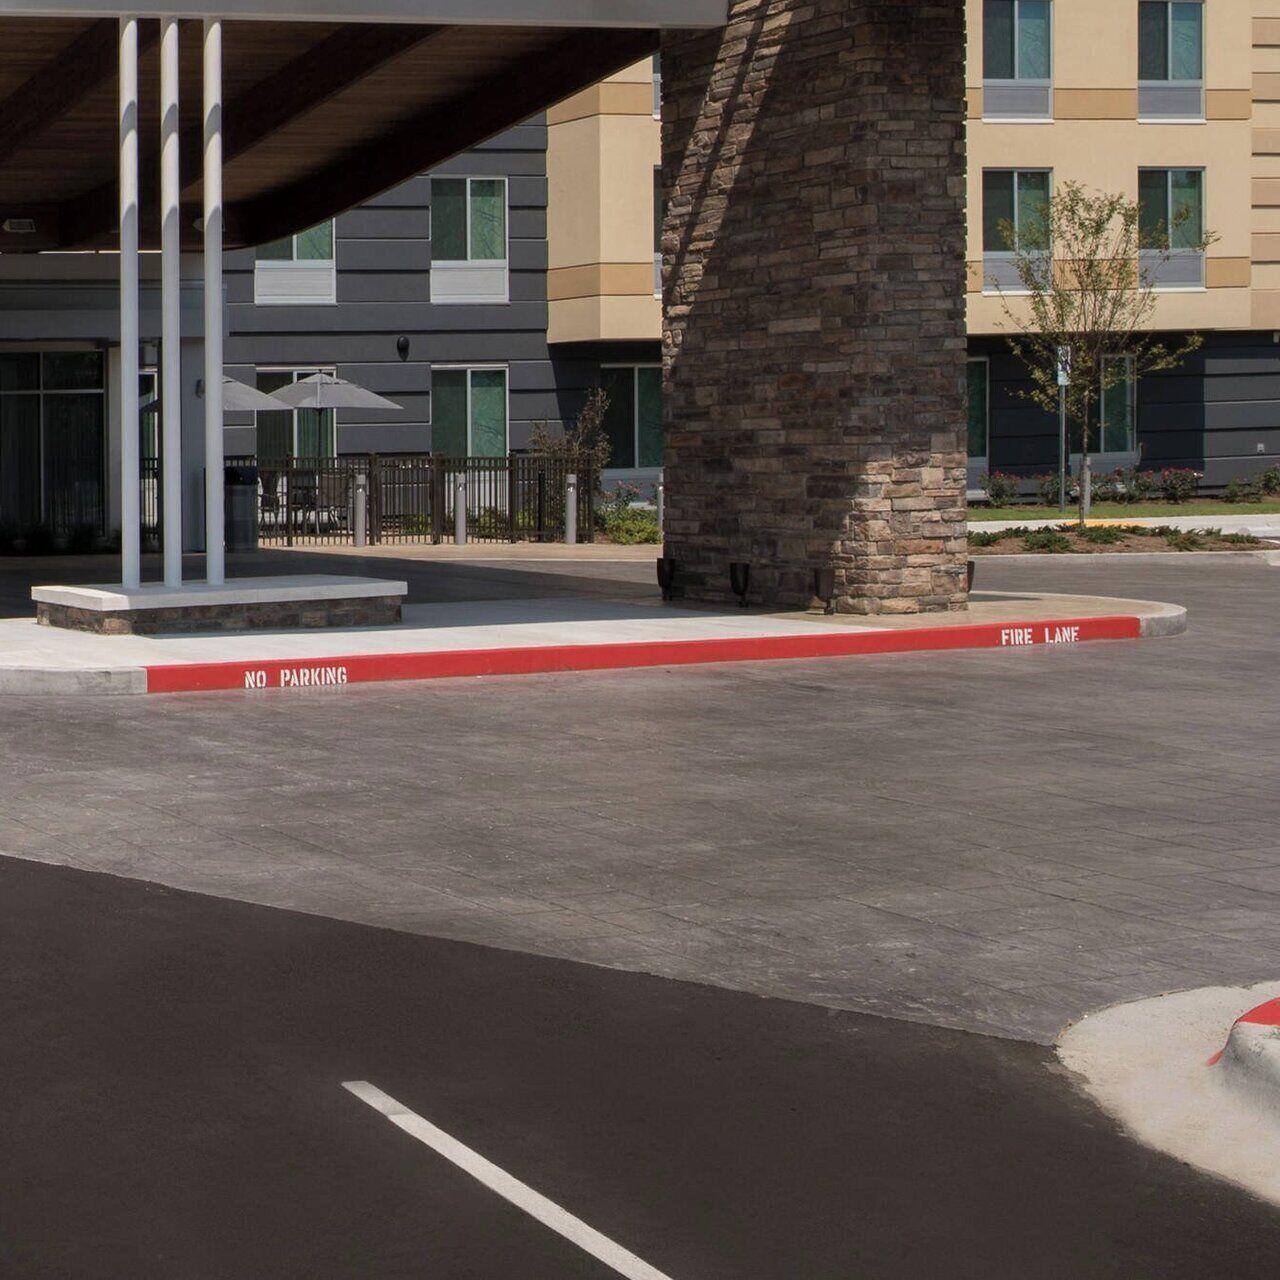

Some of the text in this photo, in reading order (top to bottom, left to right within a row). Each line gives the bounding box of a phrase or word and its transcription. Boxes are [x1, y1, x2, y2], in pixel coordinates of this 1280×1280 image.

[1001, 626, 1080, 646] FIRE LANE
[244, 666, 347, 689] NO PARKING
